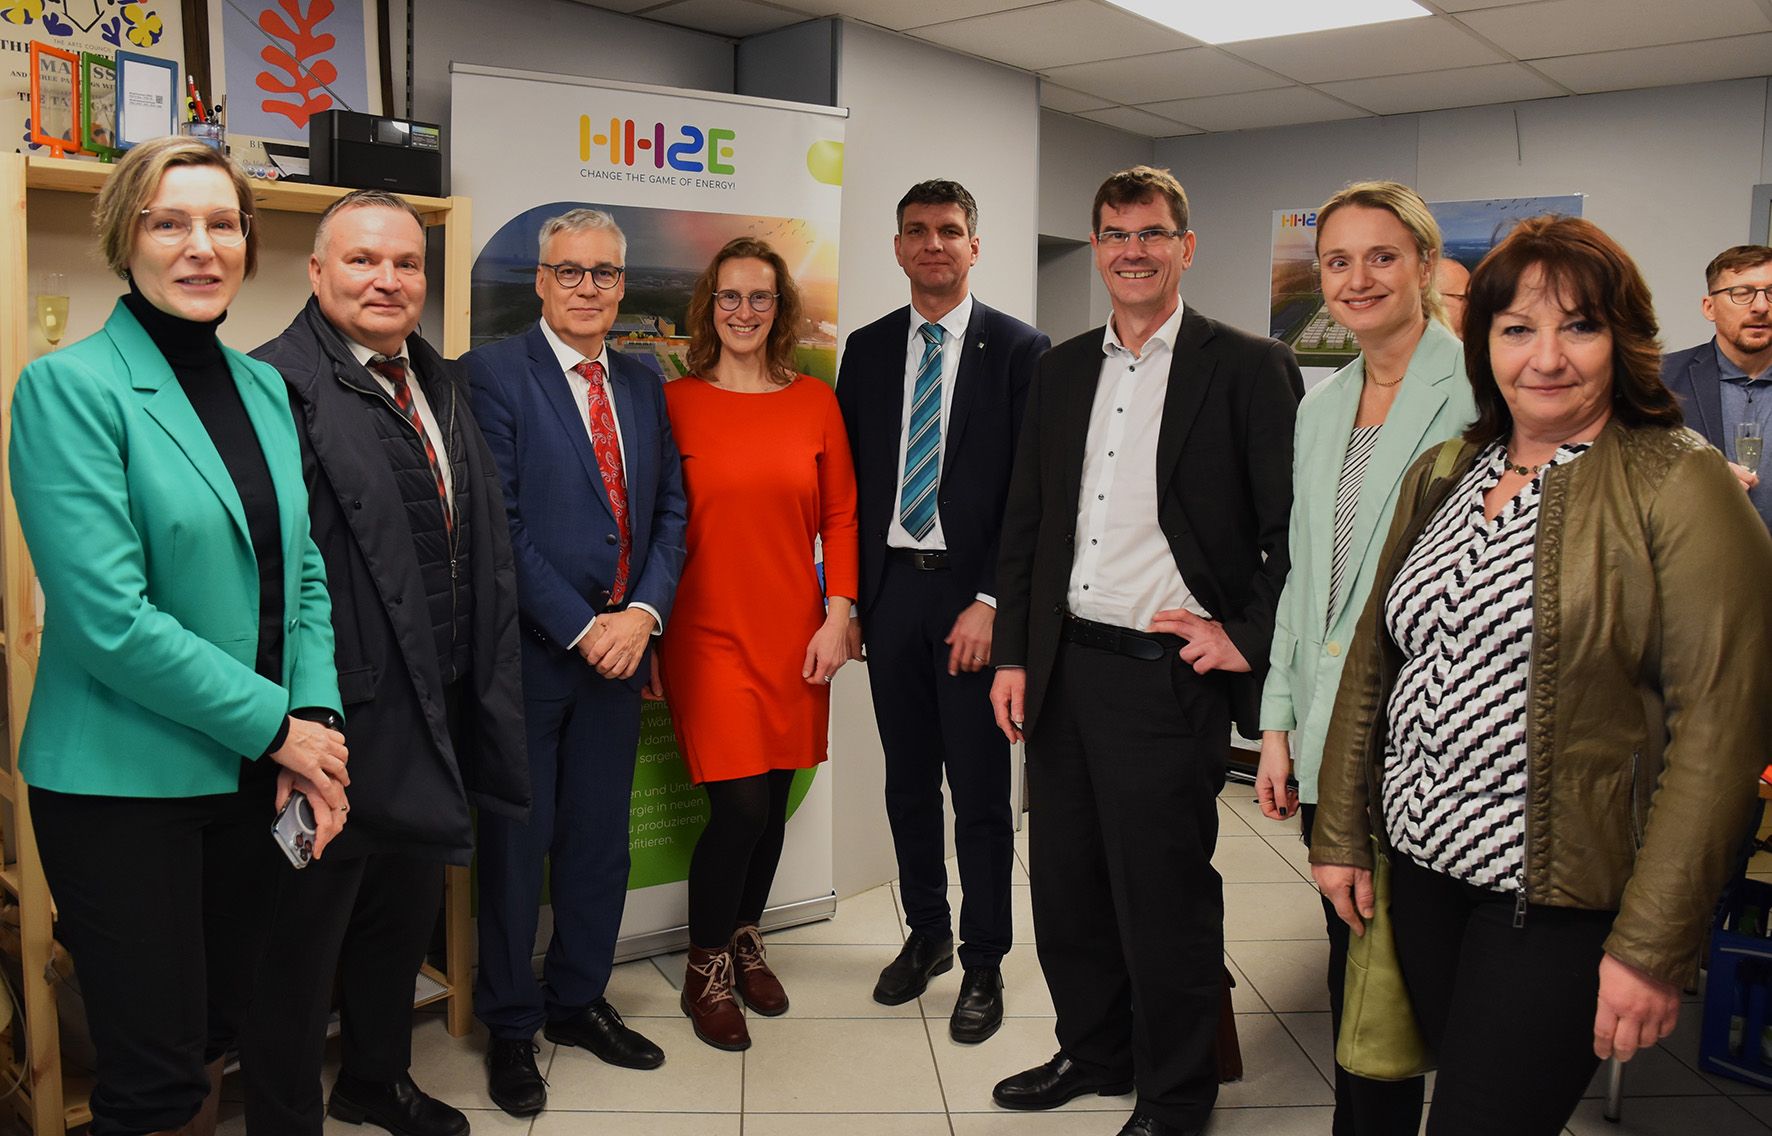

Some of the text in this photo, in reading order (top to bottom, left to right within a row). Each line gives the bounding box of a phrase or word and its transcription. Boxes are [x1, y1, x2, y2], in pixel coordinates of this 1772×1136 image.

[54, 38, 65, 46] THE
[68, 41, 82, 49] ARTS
[10, 70, 28, 78] AND
[579, 113, 736, 176] HH2E
[580, 168, 736, 190] CHANGE THE GAME OF ENERGY!
[640, 751, 681, 764] sorgen.
[645, 785, 667, 797] und
[657, 801, 667, 812] in
[670, 798, 704, 810] neuen
[637, 814, 706, 834] produzieren,
